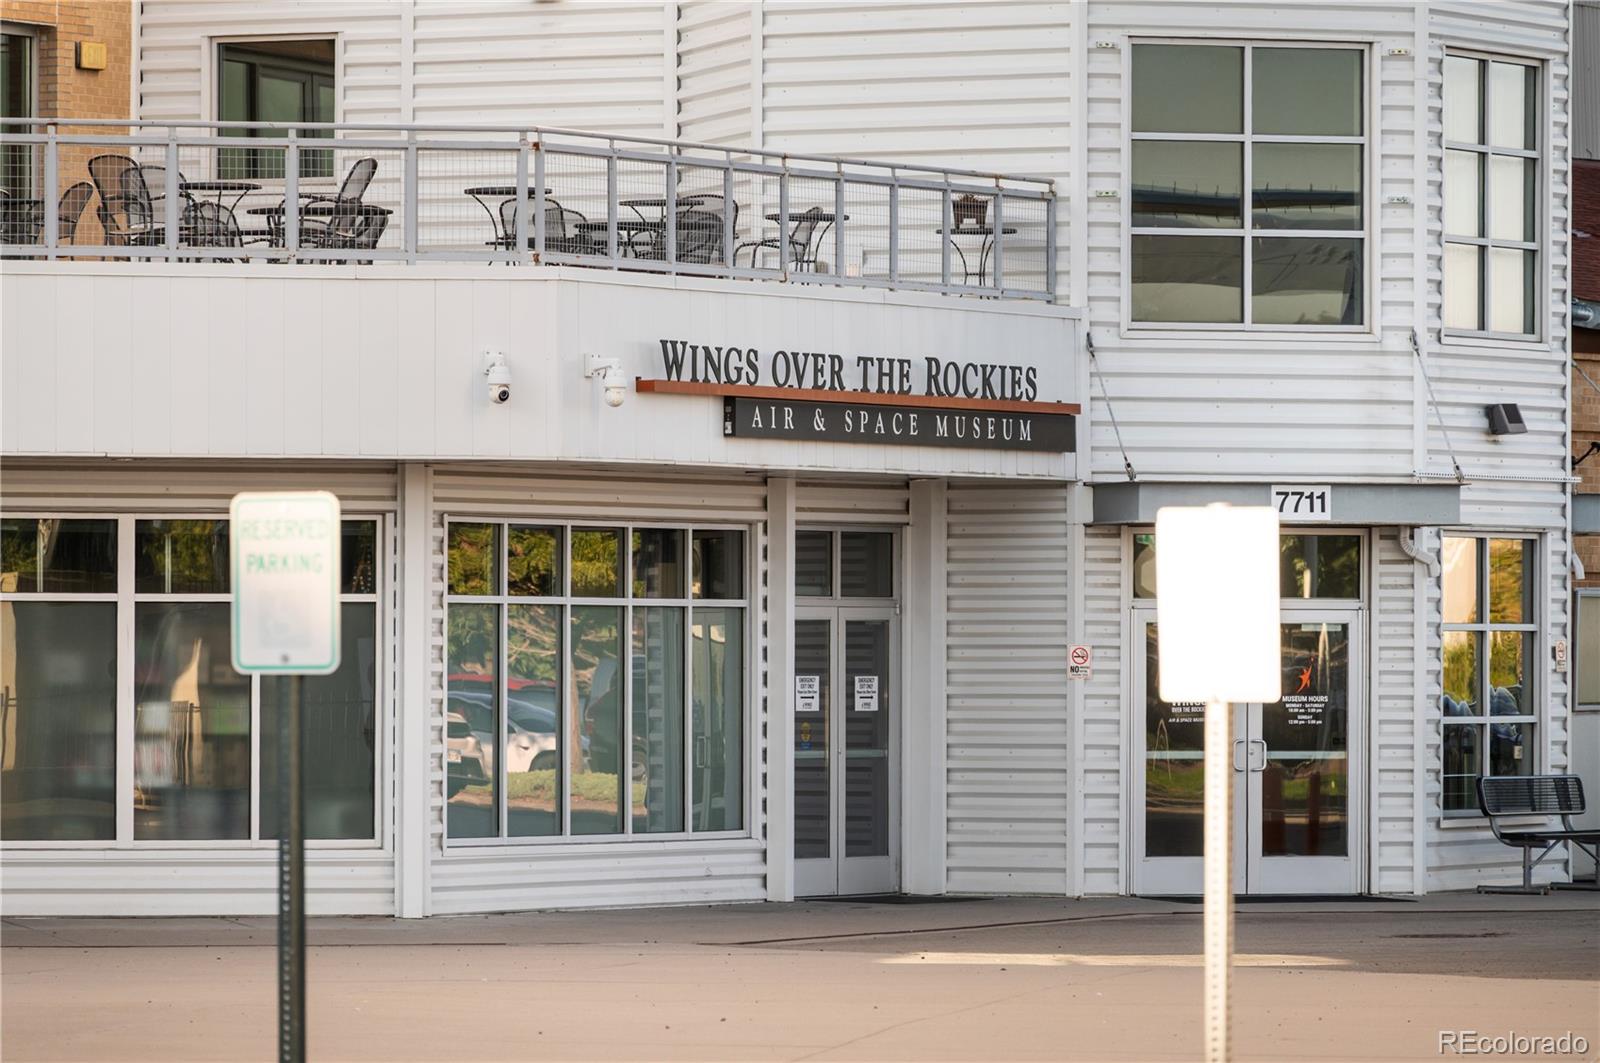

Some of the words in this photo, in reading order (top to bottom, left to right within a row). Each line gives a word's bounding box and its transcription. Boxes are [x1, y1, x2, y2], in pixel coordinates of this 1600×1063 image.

[659, 339, 760, 386] WINGS
[771, 350, 846, 390] OVER
[856, 356, 912, 394] THE
[924, 356, 1038, 402] ROCKIES
[751, 405, 795, 430] AIR
[813, 408, 826, 432] &
[844, 410, 919, 436] SPACE
[935, 415, 1032, 441] MUSEUM
[1275, 491, 1326, 513] 7711
[241, 520, 329, 540] RESERVED
[246, 553, 323, 574] PARKING
